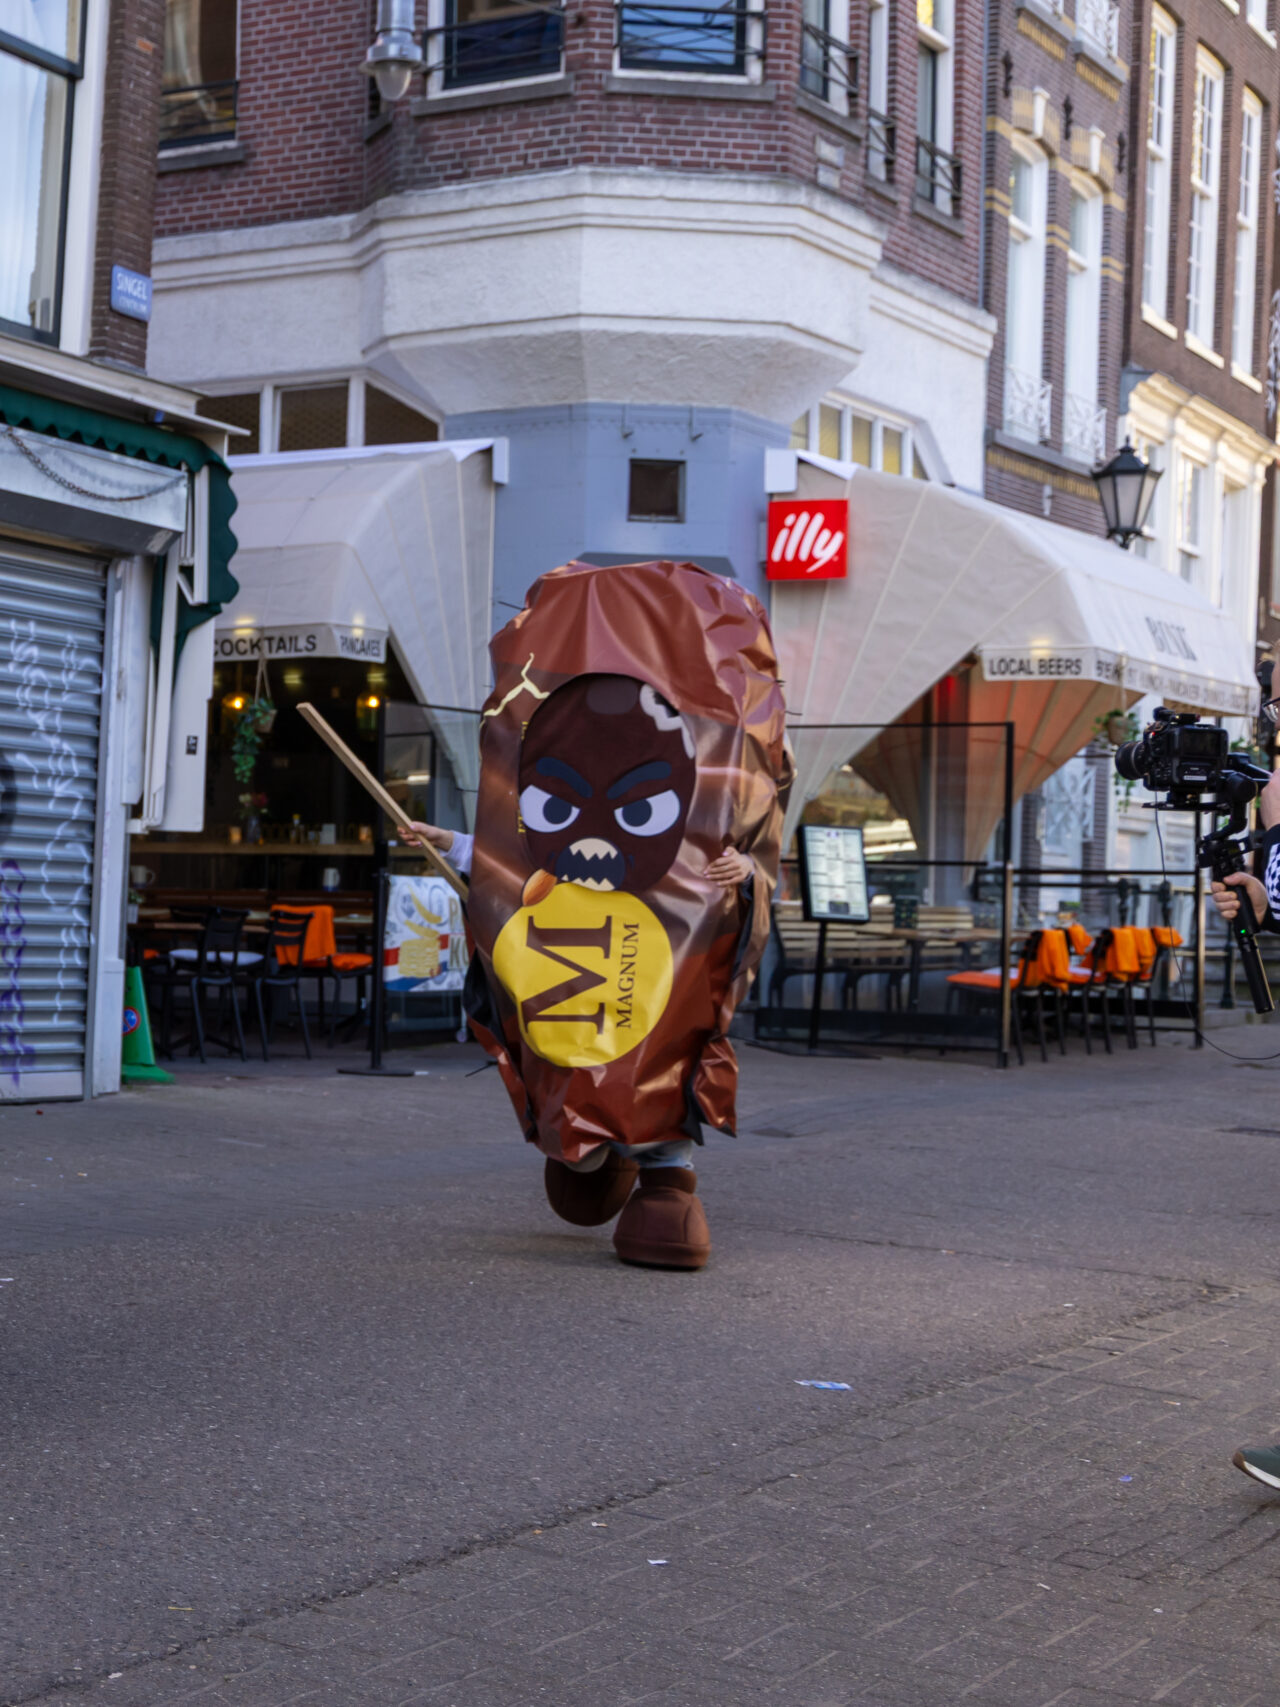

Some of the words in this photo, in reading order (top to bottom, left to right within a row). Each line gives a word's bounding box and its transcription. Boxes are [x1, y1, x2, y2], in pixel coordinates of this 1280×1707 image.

[771, 511, 844, 573] illy
[989, 659, 1034, 675] LOCAL
[1038, 658, 1082, 675] BEERS
[521, 915, 612, 1035] M
[616, 923, 640, 1029] MAGNUM
